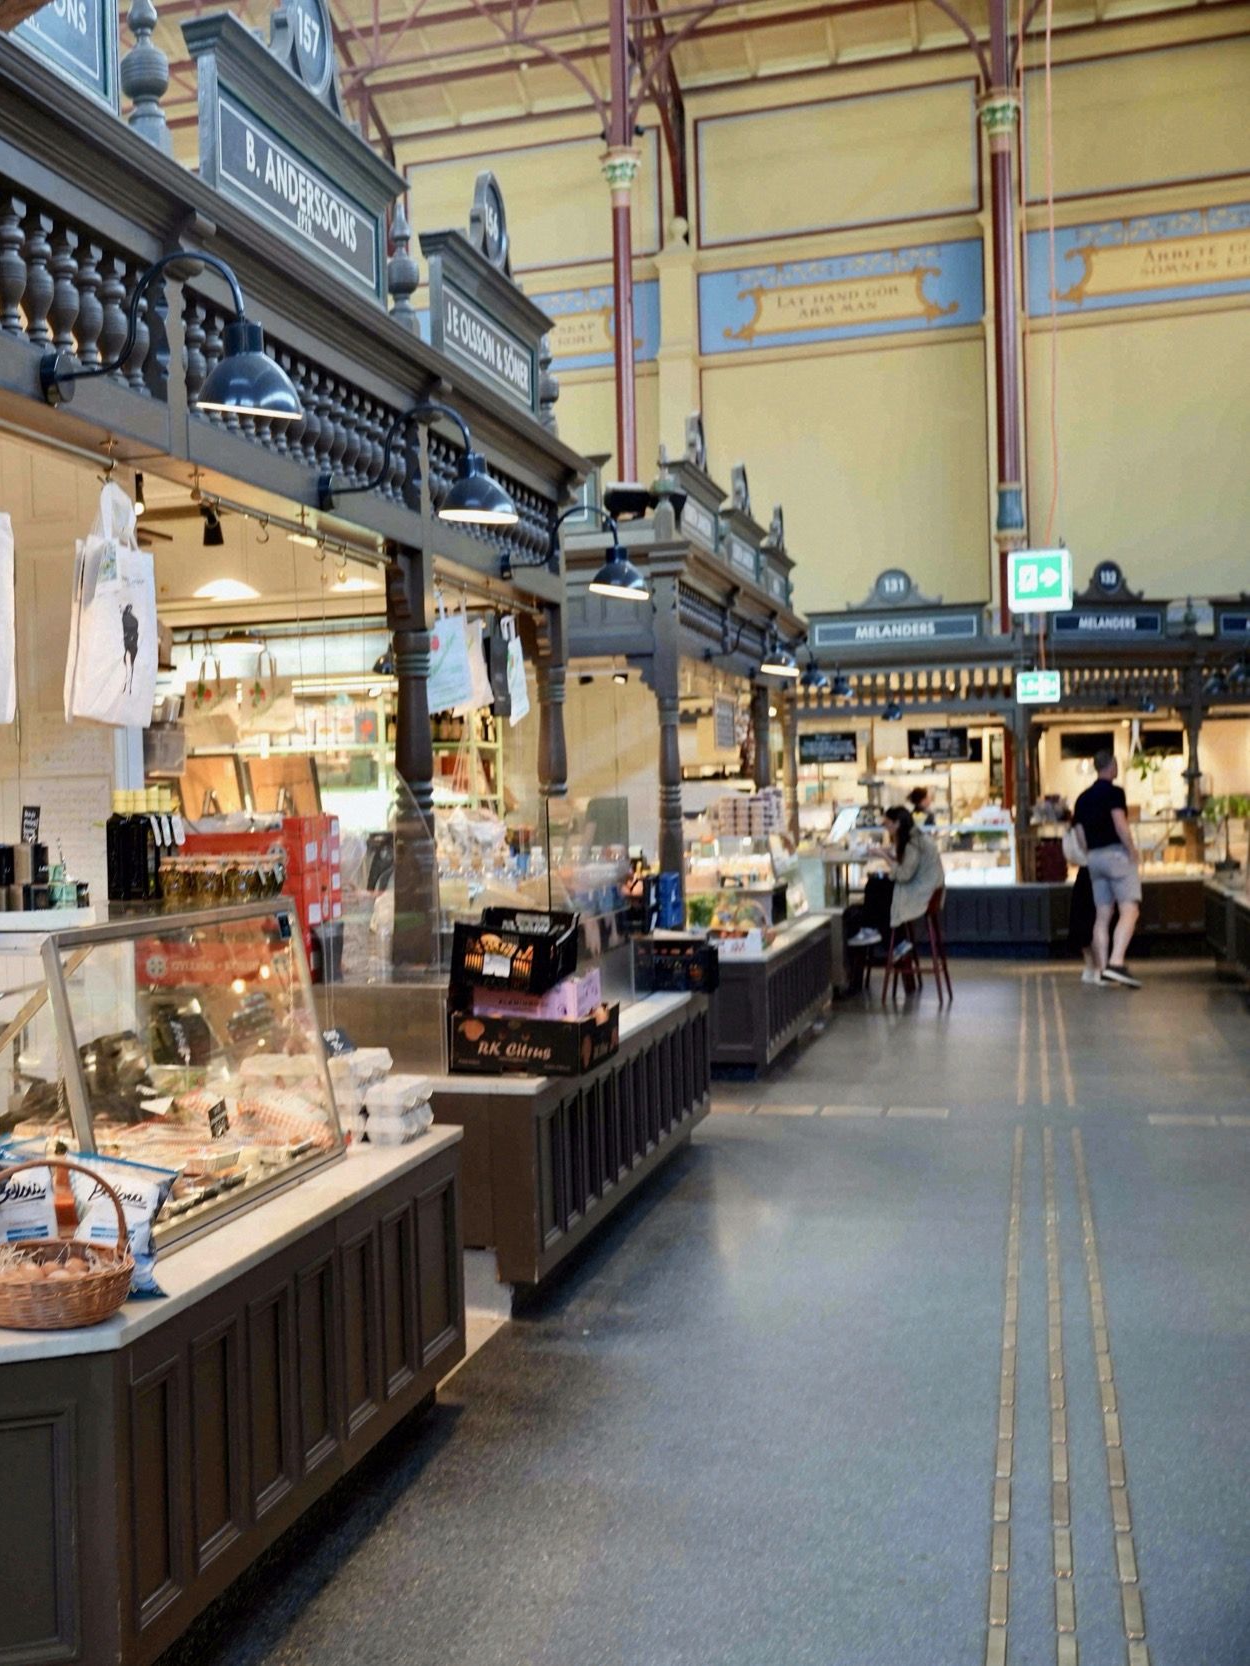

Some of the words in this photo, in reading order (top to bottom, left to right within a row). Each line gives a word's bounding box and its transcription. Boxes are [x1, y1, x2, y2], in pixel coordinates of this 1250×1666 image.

[297, 5, 320, 59] 157
[246, 128, 261, 178] B.
[264, 147, 357, 253] ANDERSSONS
[484, 203, 499, 241] 156
[813, 290, 860, 304] HAND
[452, 305, 459, 338] E
[460, 312, 495, 366] OLSSON
[496, 342, 503, 372] &
[504, 344, 529, 393] SÖNER
[884, 577, 904, 593] 131
[854, 622, 935, 641] MELANDERS
[1077, 617, 1137, 630] MELANDERS
[506, 1041, 552, 1061] Citrus
